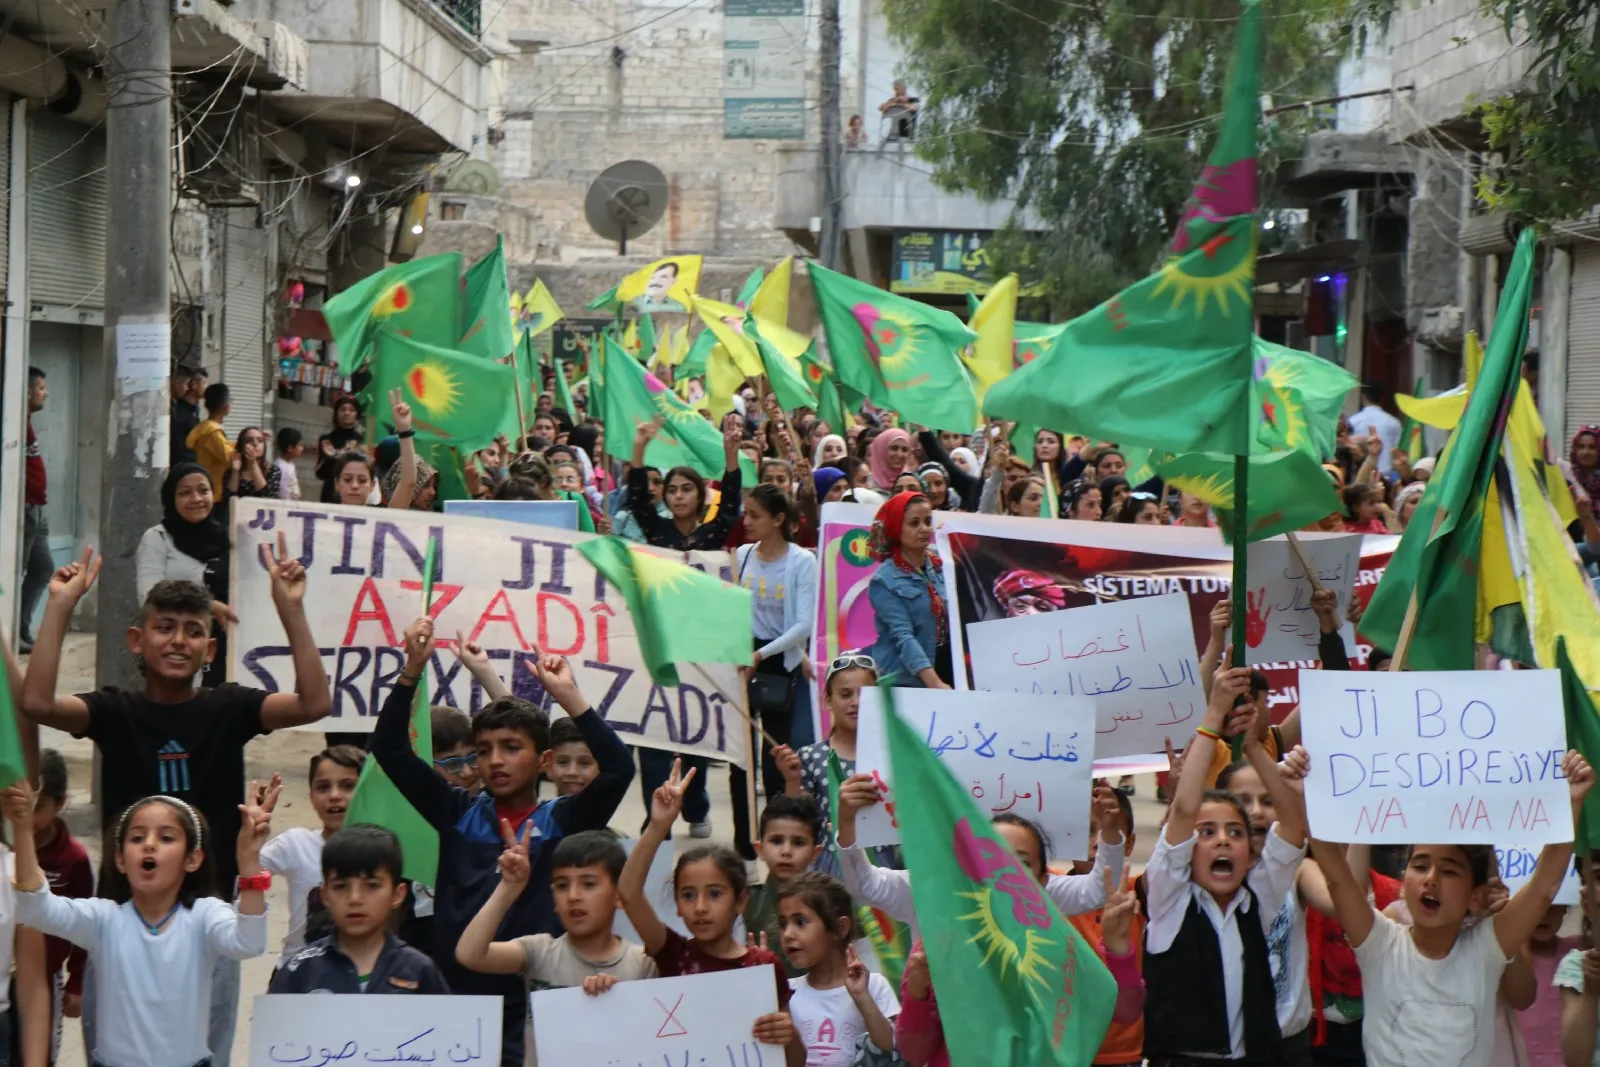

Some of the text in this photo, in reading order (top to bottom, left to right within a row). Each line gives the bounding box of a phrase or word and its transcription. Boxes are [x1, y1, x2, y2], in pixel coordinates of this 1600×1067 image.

[342, 576, 616, 664] AZADÎ
[1354, 795, 1550, 835] NA NA NA
[363, 1028, 436, 1067] يسكت
[447, 1017, 482, 1063] لن
